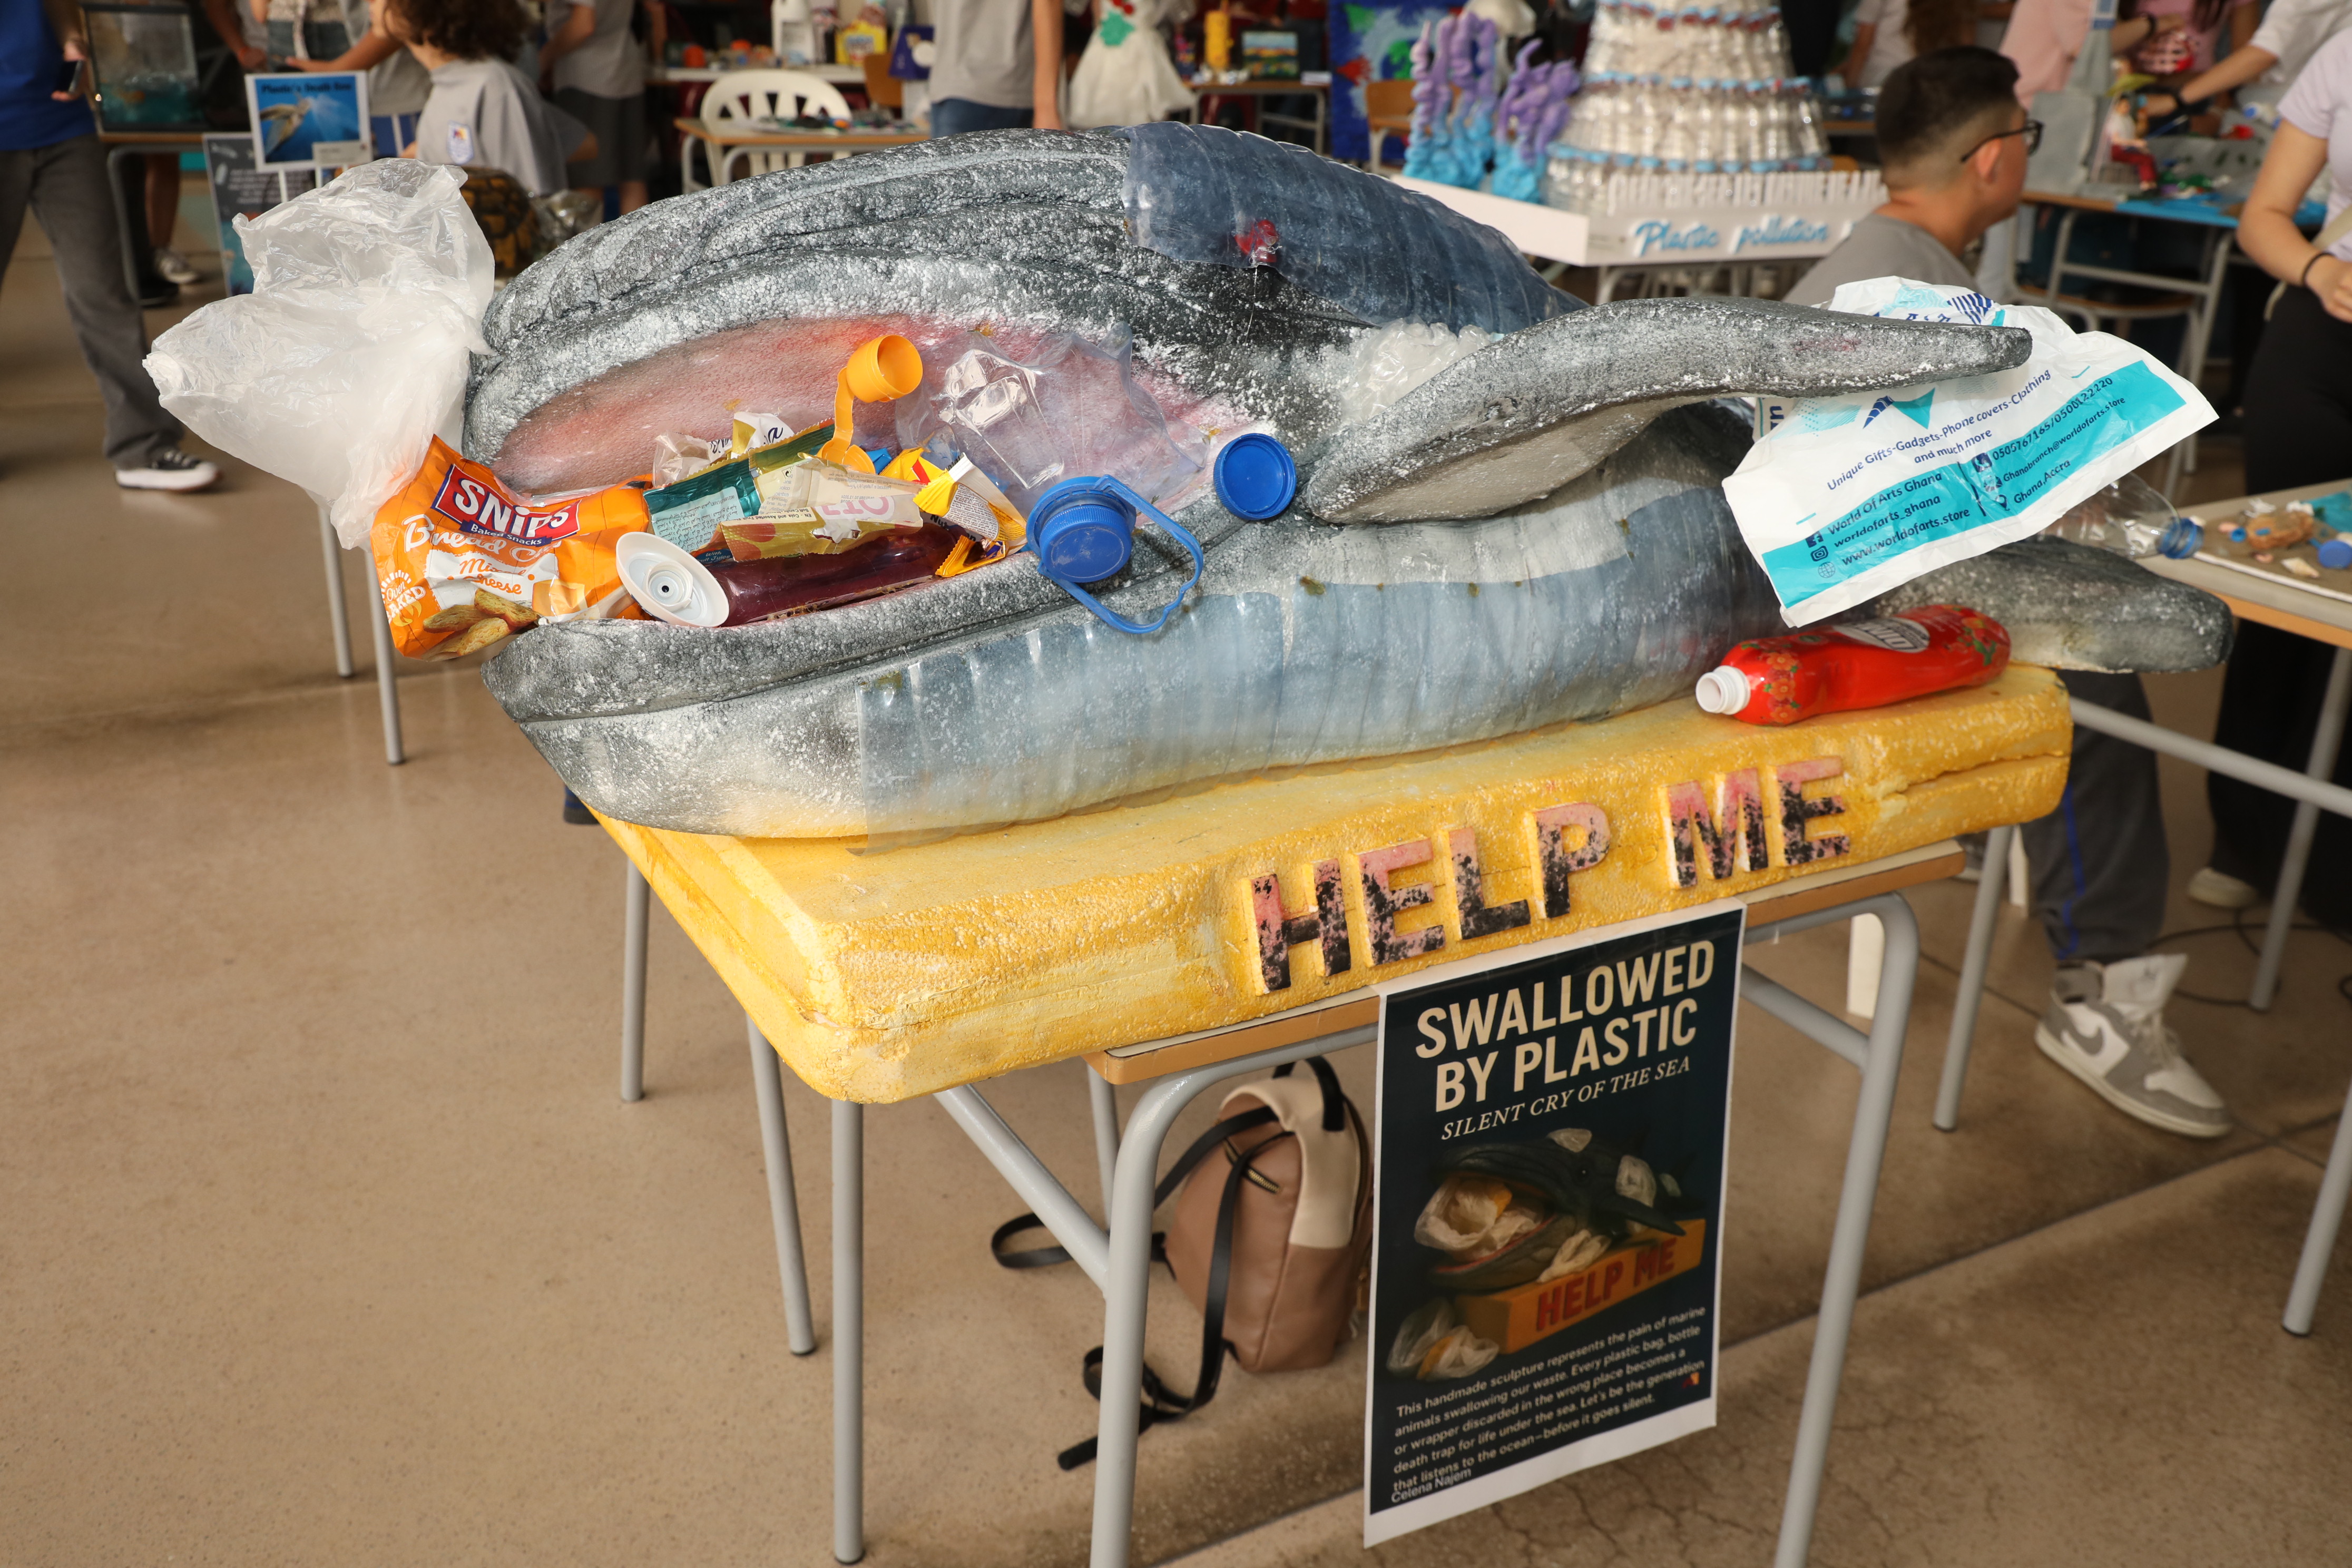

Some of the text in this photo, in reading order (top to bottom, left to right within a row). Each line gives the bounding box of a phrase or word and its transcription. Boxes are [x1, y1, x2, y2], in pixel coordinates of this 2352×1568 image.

[1633, 219, 1720, 257] Plastic
[1731, 214, 1828, 254] pollution
[1827, 369, 2051, 491] Unique Gifts-Gadgets-Phone covers-Clothing
[1914, 428, 1992, 464] and much more
[1827, 473, 1942, 535] World Of Arts Ghana
[1834, 496, 1941, 548] worldofarts_ghana
[2014, 459, 2071, 504] Ghana,Accra
[401, 514, 507, 555] Bread
[471, 525, 542, 545] Baked Snacks
[1842, 508, 1971, 565] www.worldofarts.store
[386, 581, 406, 601] Oven
[1242, 755, 1849, 995] HELP ME
[1415, 940, 1715, 1059] SWALLOWED
[1435, 998, 1699, 1113] BY PLASTIC
[1441, 1055, 1691, 1141] SILENT CRY OF THE SEA
[1536, 1238, 1677, 1331] HELP ME
[1394, 1348, 1686, 1456] or wrapper discarded in the wrong place becomes a
[1395, 1414, 1441, 1437] animals
[1443, 1391, 1508, 1421] swallowing
[1510, 1384, 1531, 1397] our
[1533, 1371, 1569, 1390] waste.
[1571, 1358, 1602, 1376] Every
[1603, 1345, 1641, 1367] plastic
[1667, 1325, 1701, 1344] bottle
[1396, 1307, 1706, 1417] This handmade sculpture represents the pain of marine
[1393, 1475, 1418, 1492] that
[1421, 1462, 1459, 1483] listens
[1462, 1457, 1475, 1467] to
[1477, 1449, 1497, 1463] the
[1581, 1414, 1591, 1425] it
[1592, 1405, 1621, 1424] goes
[1622, 1393, 1655, 1413] silent.
[1394, 1453, 1428, 1474] death
[1431, 1445, 1455, 1461] trap
[1458, 1437, 1476, 1452] for
[1478, 1430, 1497, 1445] life
[1499, 1417, 1532, 1437] under
[1535, 1410, 1554, 1425] the
[1556, 1403, 1579, 1417] sea.
[1609, 1386, 1624, 1399] be
[1626, 1379, 1645, 1393] the
[1647, 1359, 1706, 1389] generation
[1391, 1468, 1472, 1503] Celena Najem
